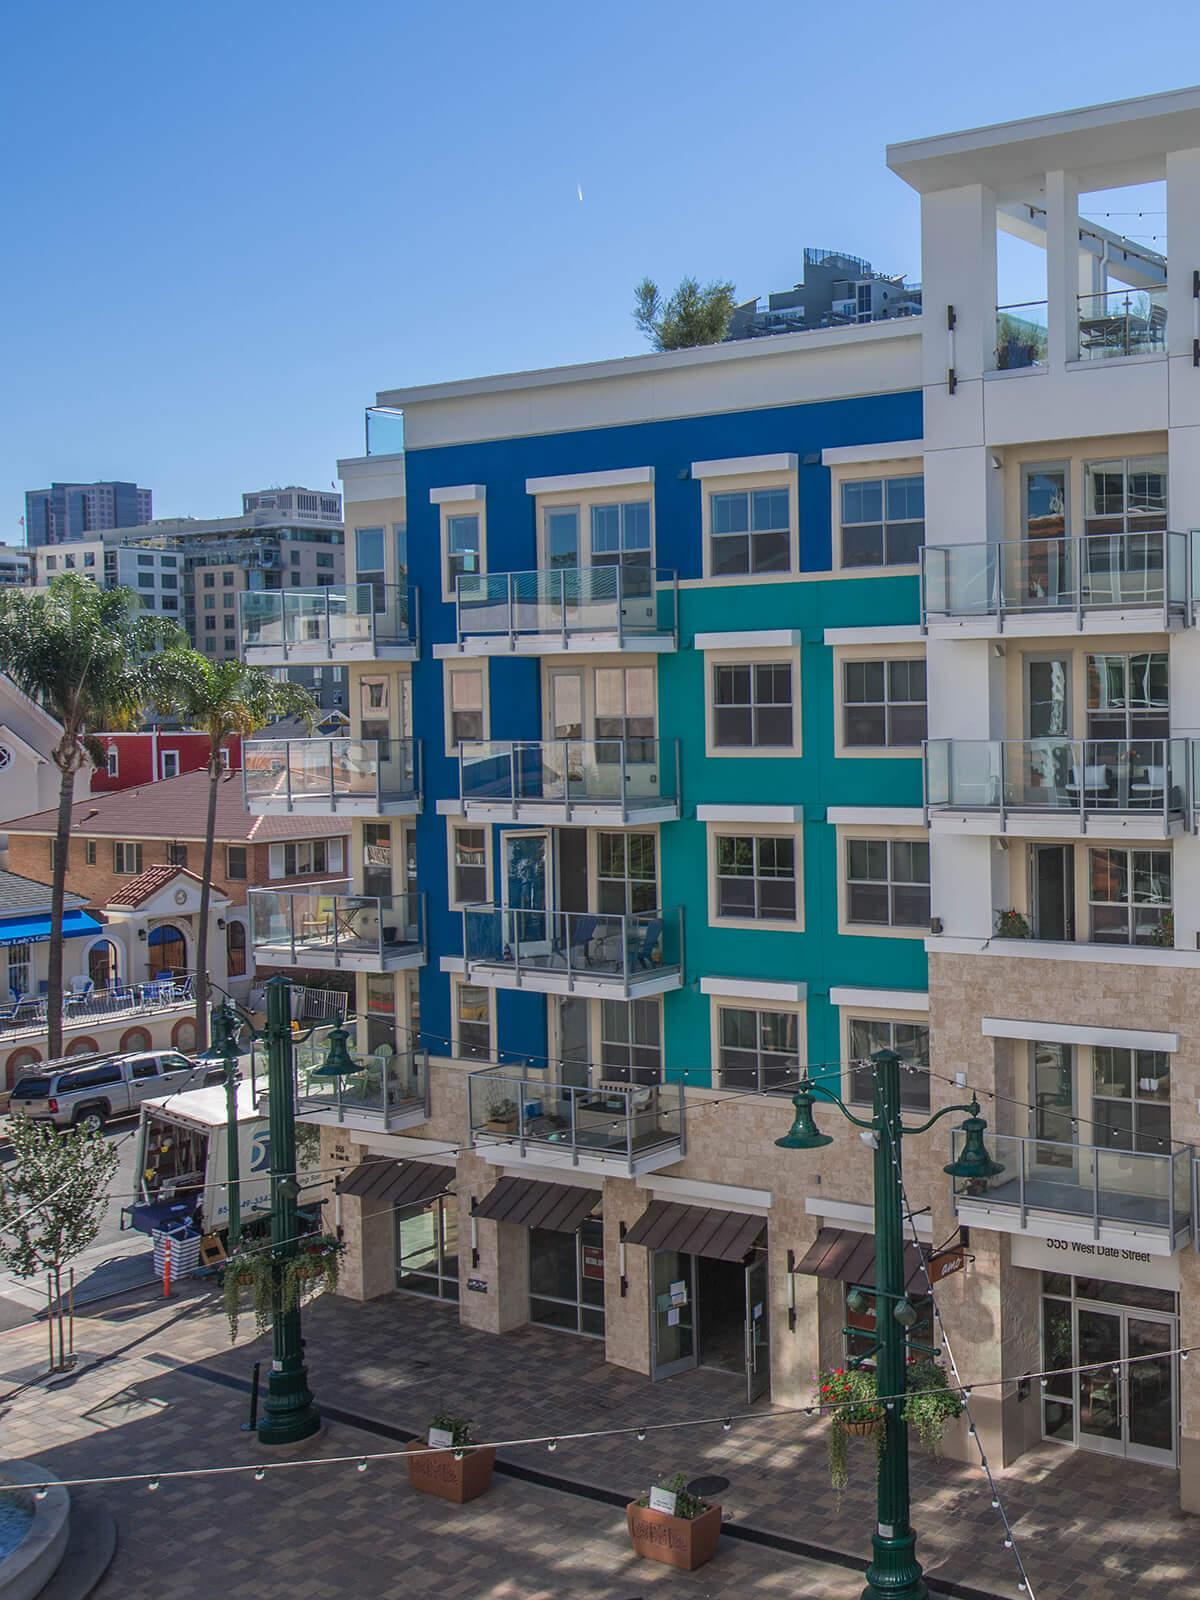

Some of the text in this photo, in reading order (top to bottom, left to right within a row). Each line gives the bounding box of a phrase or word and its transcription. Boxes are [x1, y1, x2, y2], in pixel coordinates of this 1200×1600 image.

[1071, 1241, 1095, 1254] West
[1096, 1245, 1120, 1258] Date
[1121, 1248, 1152, 1263] Street
